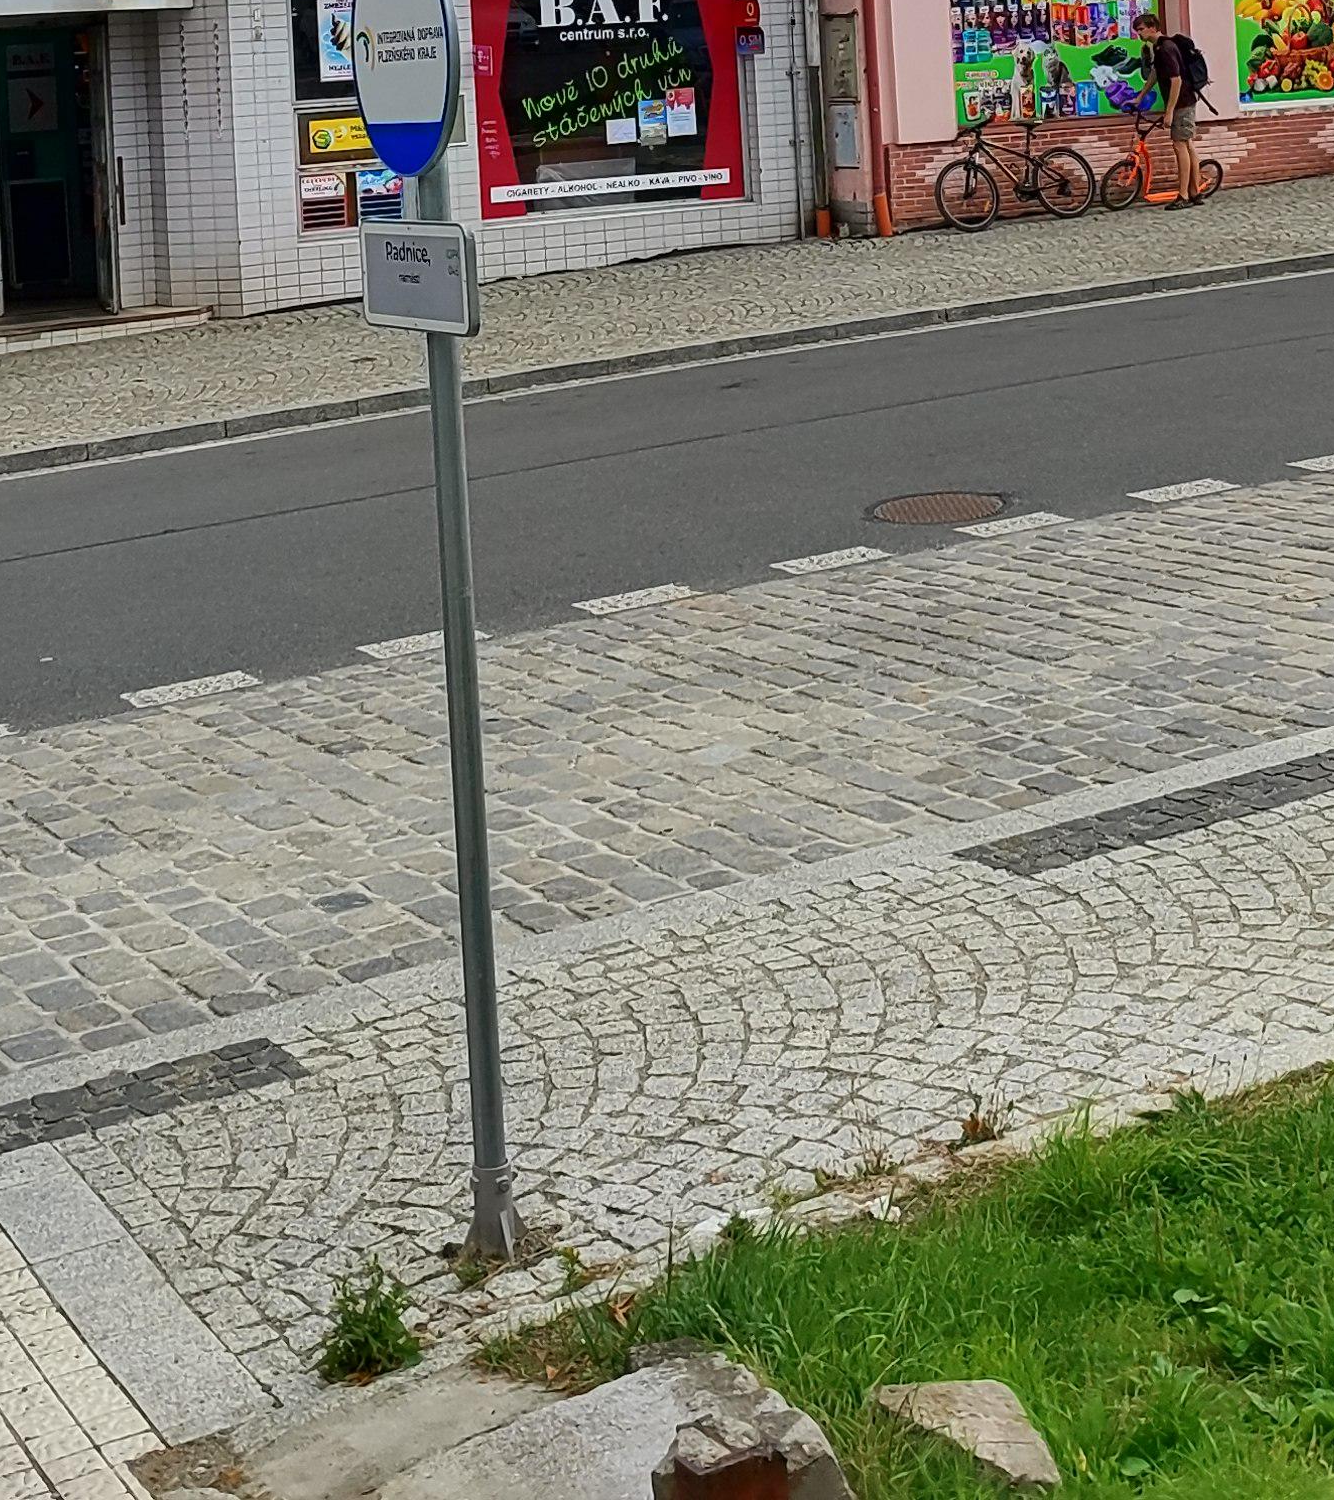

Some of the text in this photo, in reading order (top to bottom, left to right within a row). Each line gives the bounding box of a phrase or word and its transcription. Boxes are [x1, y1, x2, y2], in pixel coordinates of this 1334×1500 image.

[559, 28, 650, 42] centrum s.r.o.
[617, 36, 683, 79] druhů
[678, 173, 697, 182] PIVO
[385, 241, 431, 267] Radnice,
